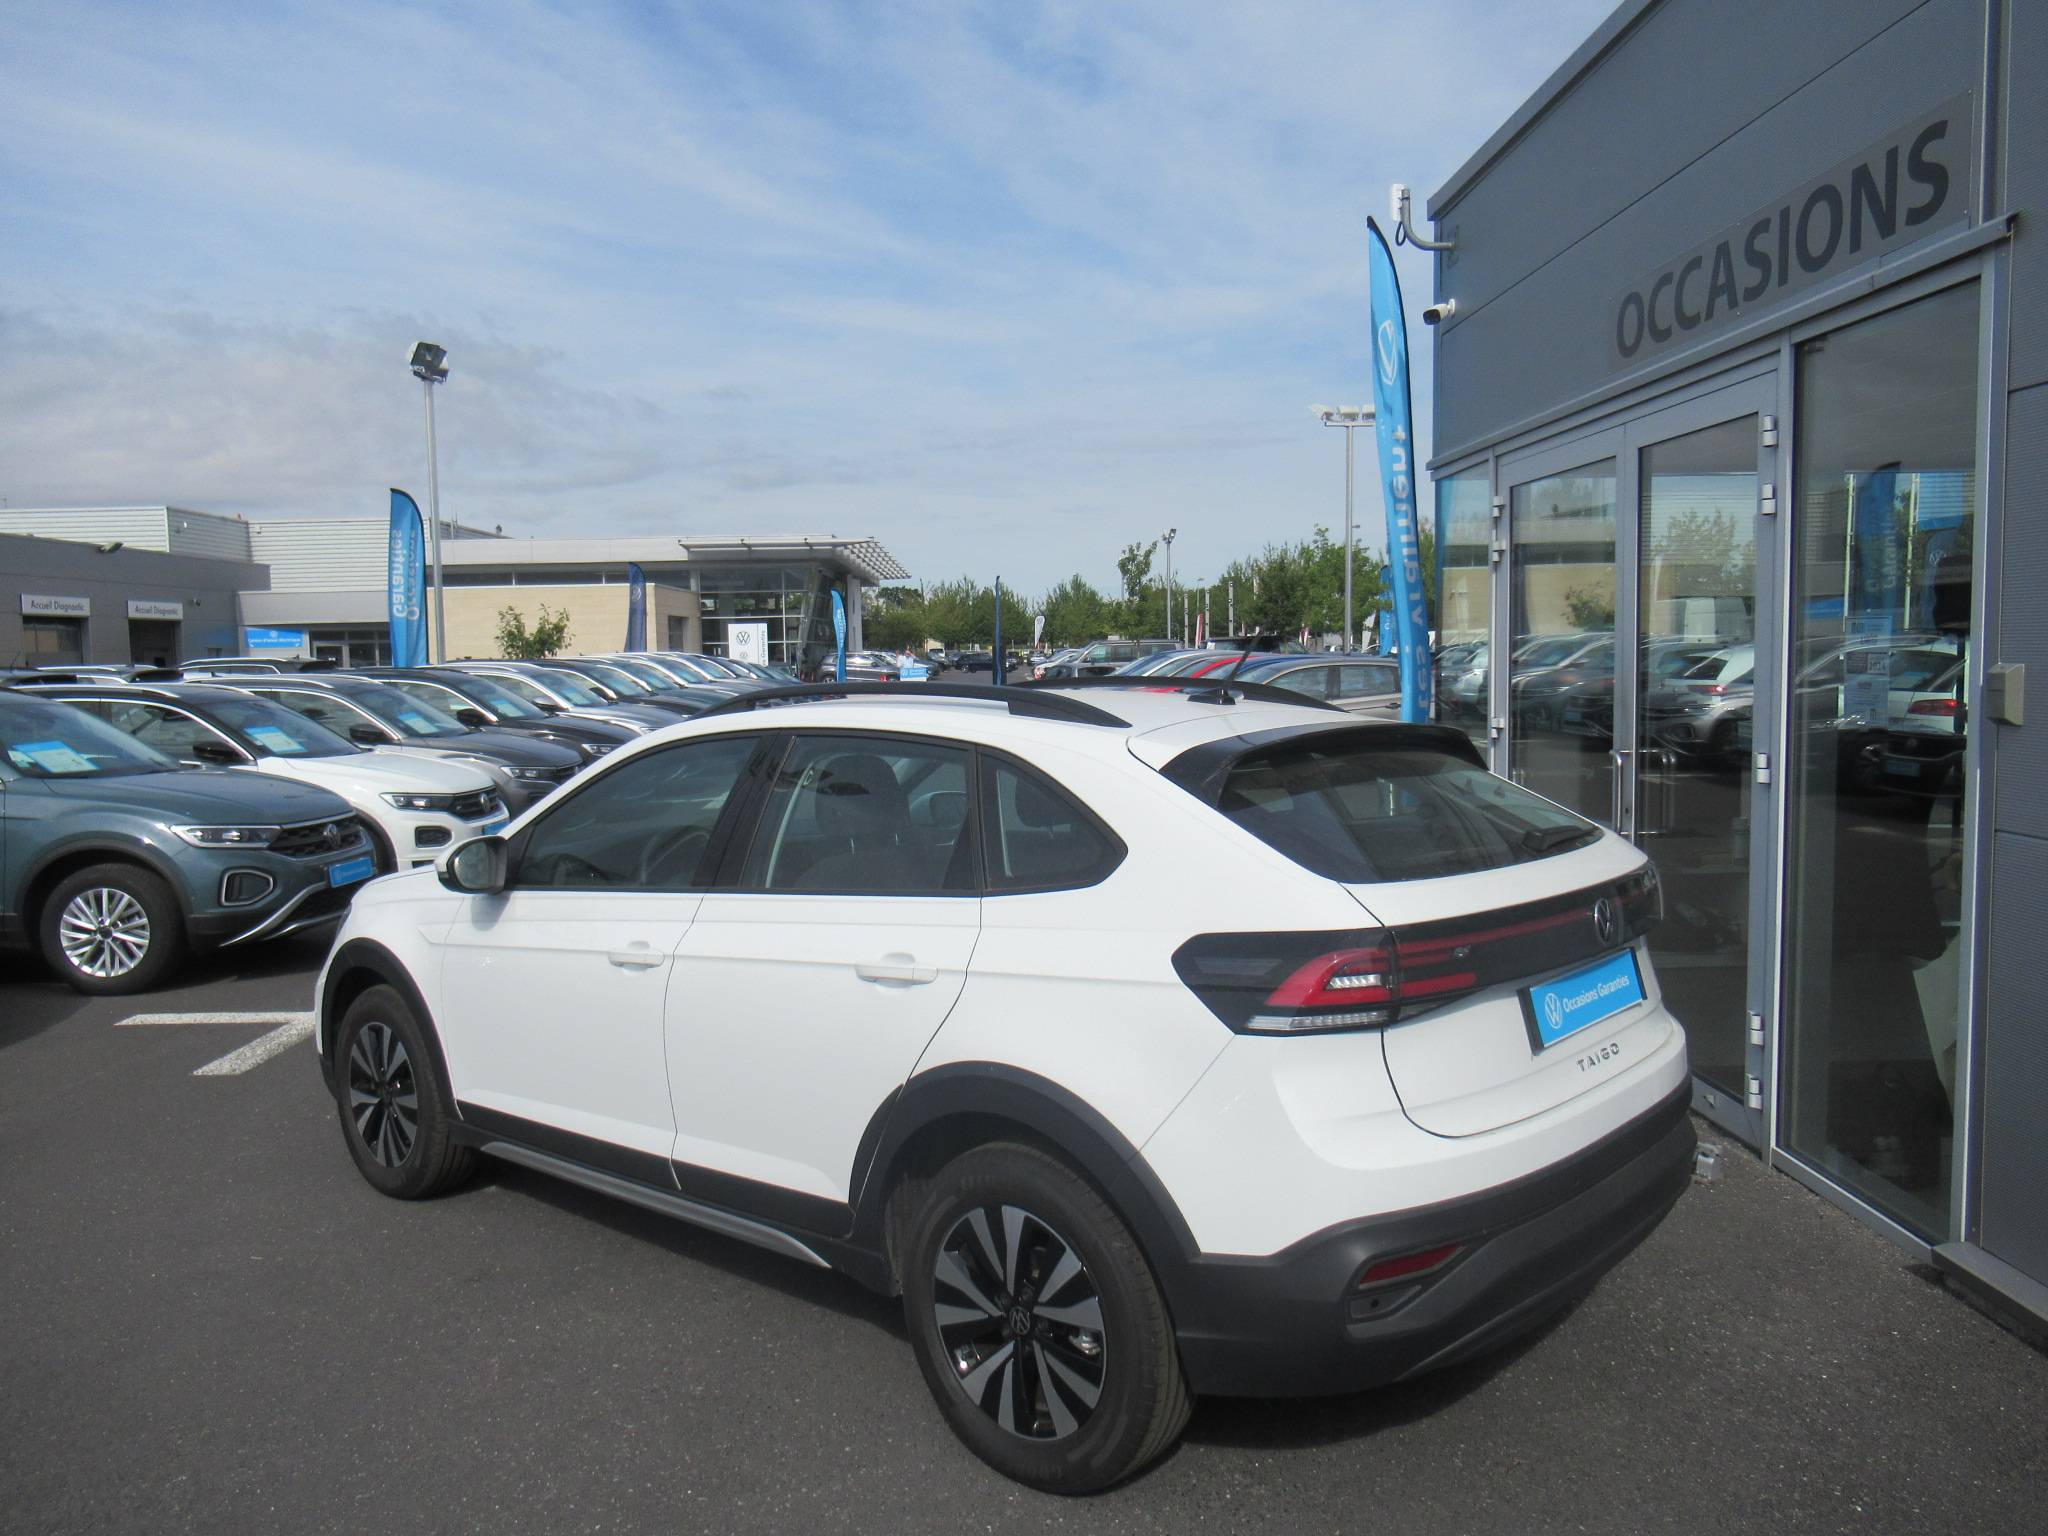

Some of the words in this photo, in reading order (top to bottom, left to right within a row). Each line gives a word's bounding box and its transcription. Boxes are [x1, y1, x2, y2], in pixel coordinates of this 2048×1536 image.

[1615, 119, 1950, 359] OCCASIONS
[31, 599, 53, 610] Accueil
[54, 600, 86, 613] Diagnostic
[1563, 988, 1598, 1013] Occasions
[1597, 974, 1630, 997] Garanties
[1576, 1042, 1620, 1072] TAIGO
